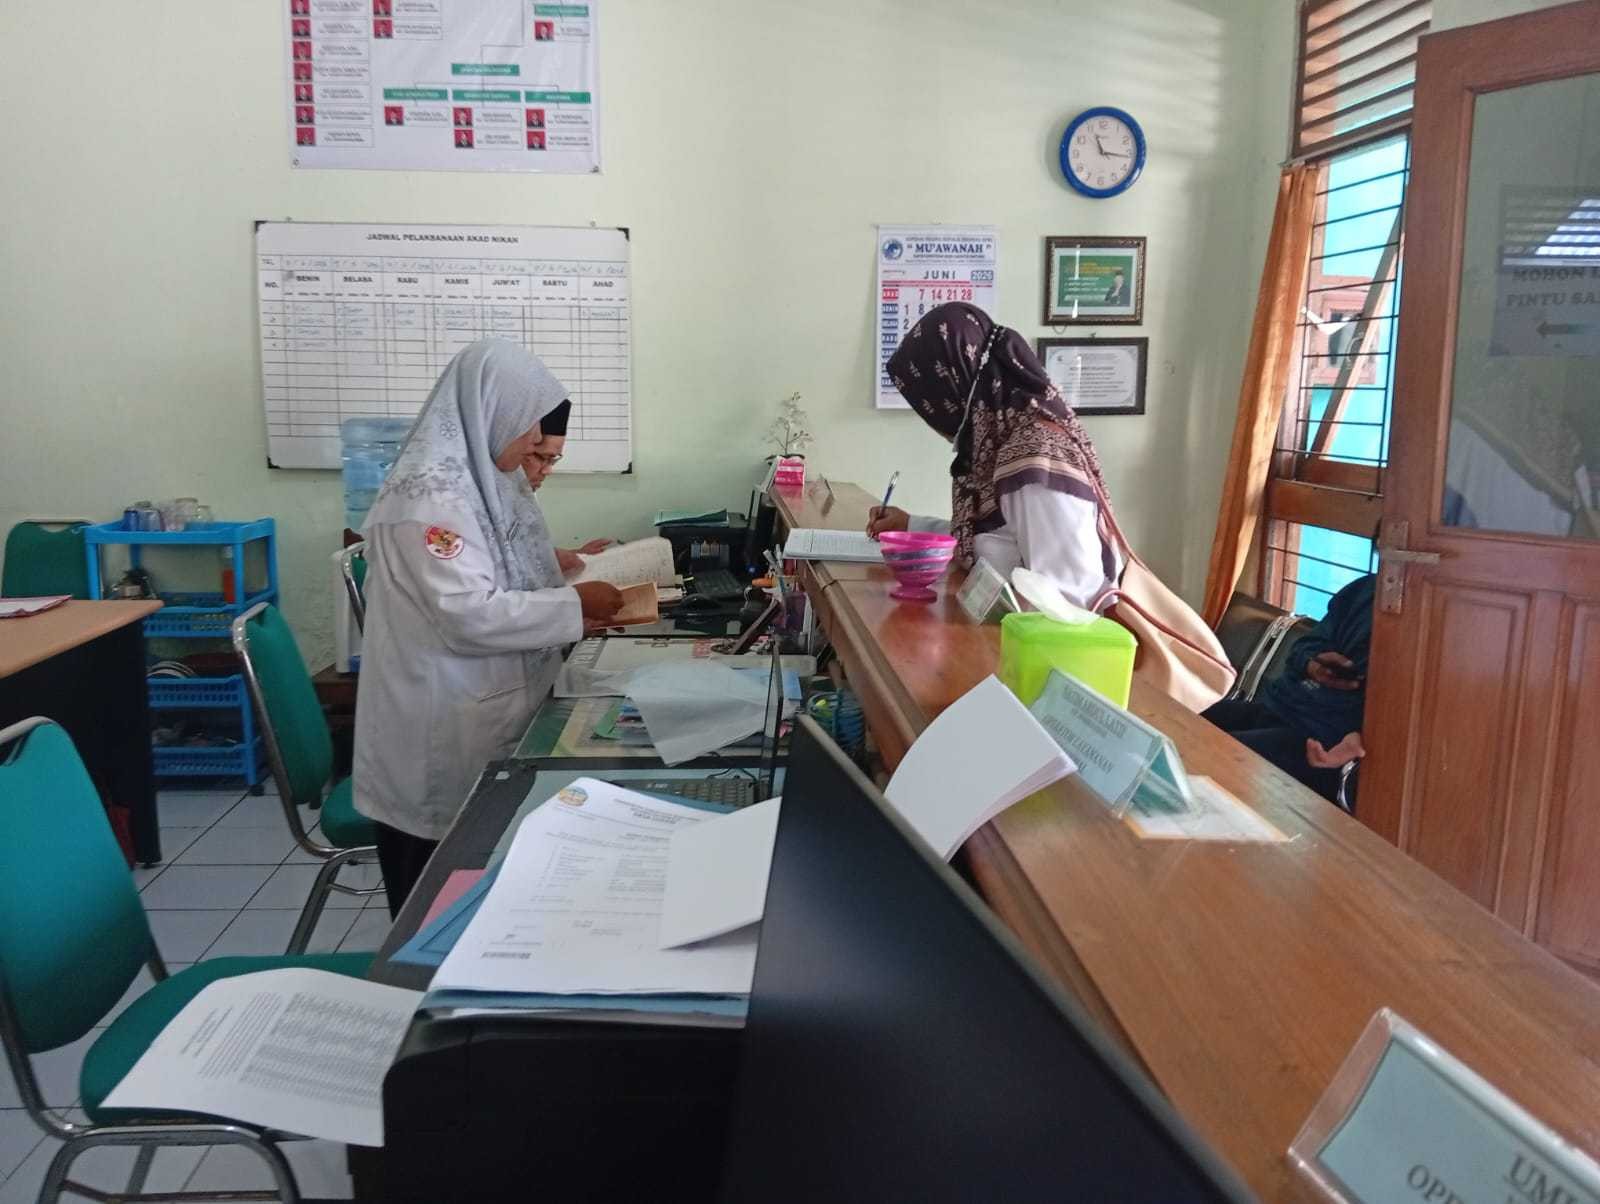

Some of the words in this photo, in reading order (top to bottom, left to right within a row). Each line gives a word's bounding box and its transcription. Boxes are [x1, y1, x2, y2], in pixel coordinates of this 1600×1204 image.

[366, 233, 402, 242] JADWAL
[915, 243, 983, 254] MU'AWANAH
[923, 270, 957, 280] JUNI
[444, 278, 469, 286] KAMIS
[919, 289, 925, 300] 7
[931, 289, 942, 300] 14
[946, 289, 957, 300] 21
[961, 289, 973, 300] 28
[918, 304, 925, 315] 8
[903, 319, 910, 330] 2
